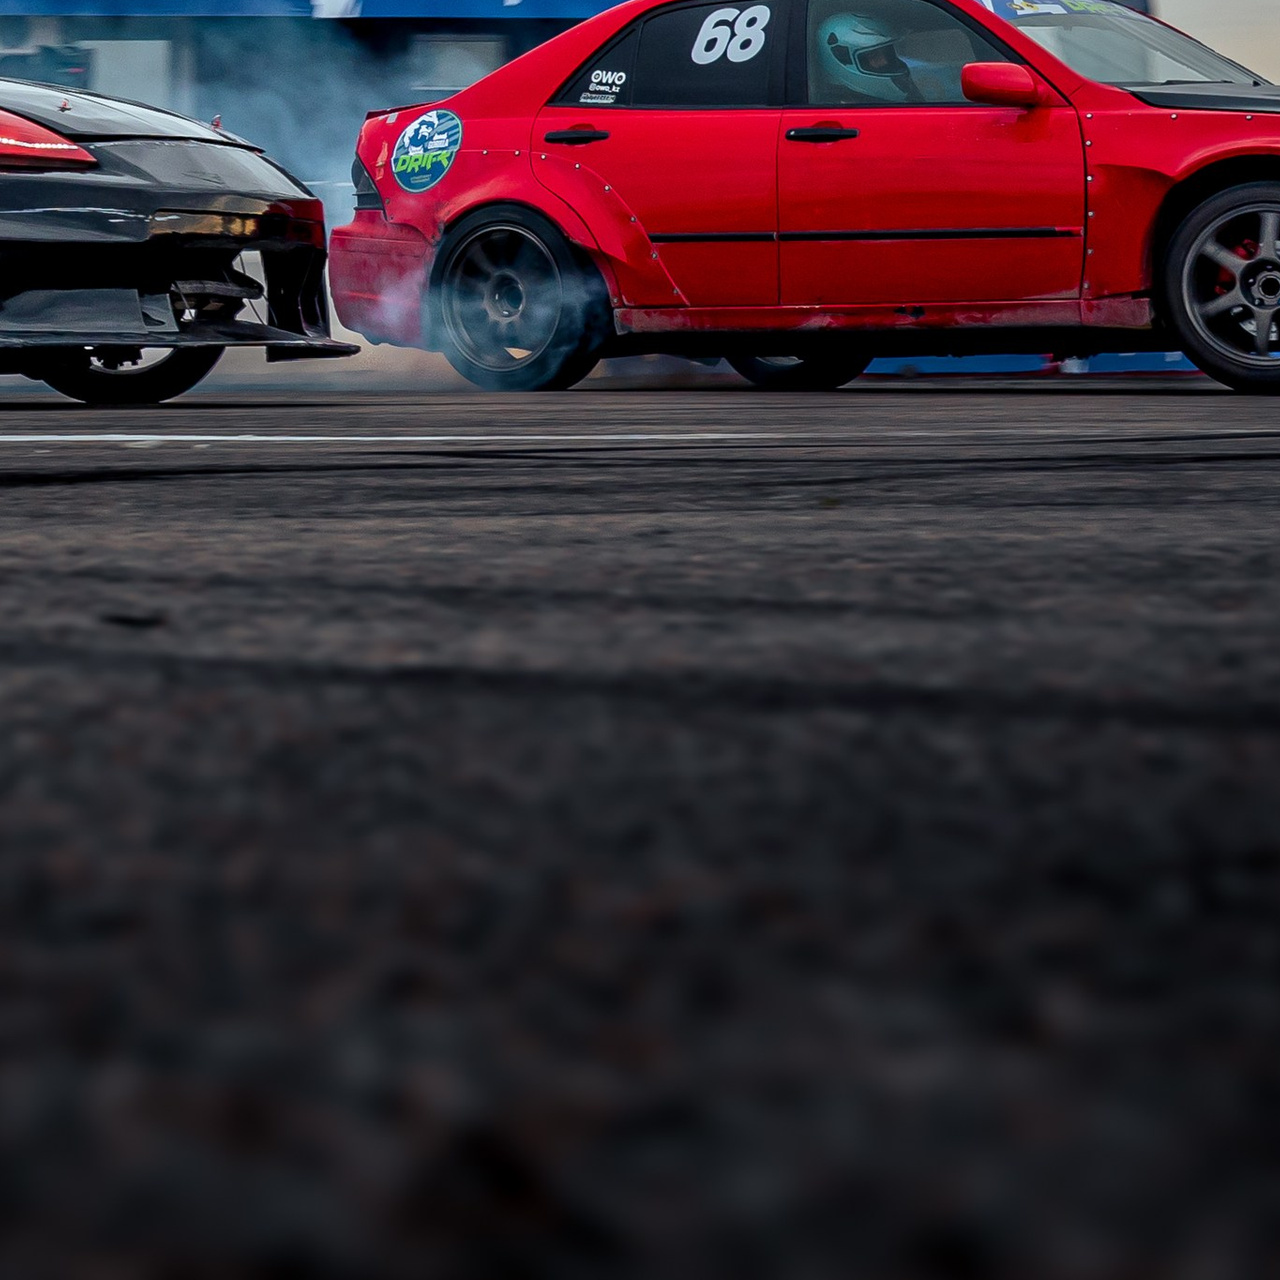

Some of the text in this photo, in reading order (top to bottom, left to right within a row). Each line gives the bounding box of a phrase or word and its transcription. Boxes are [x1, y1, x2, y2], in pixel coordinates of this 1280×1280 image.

[690, 4, 771, 65] 68
[591, 70, 626, 85] OWO
[395, 150, 451, 174] DRIFT
